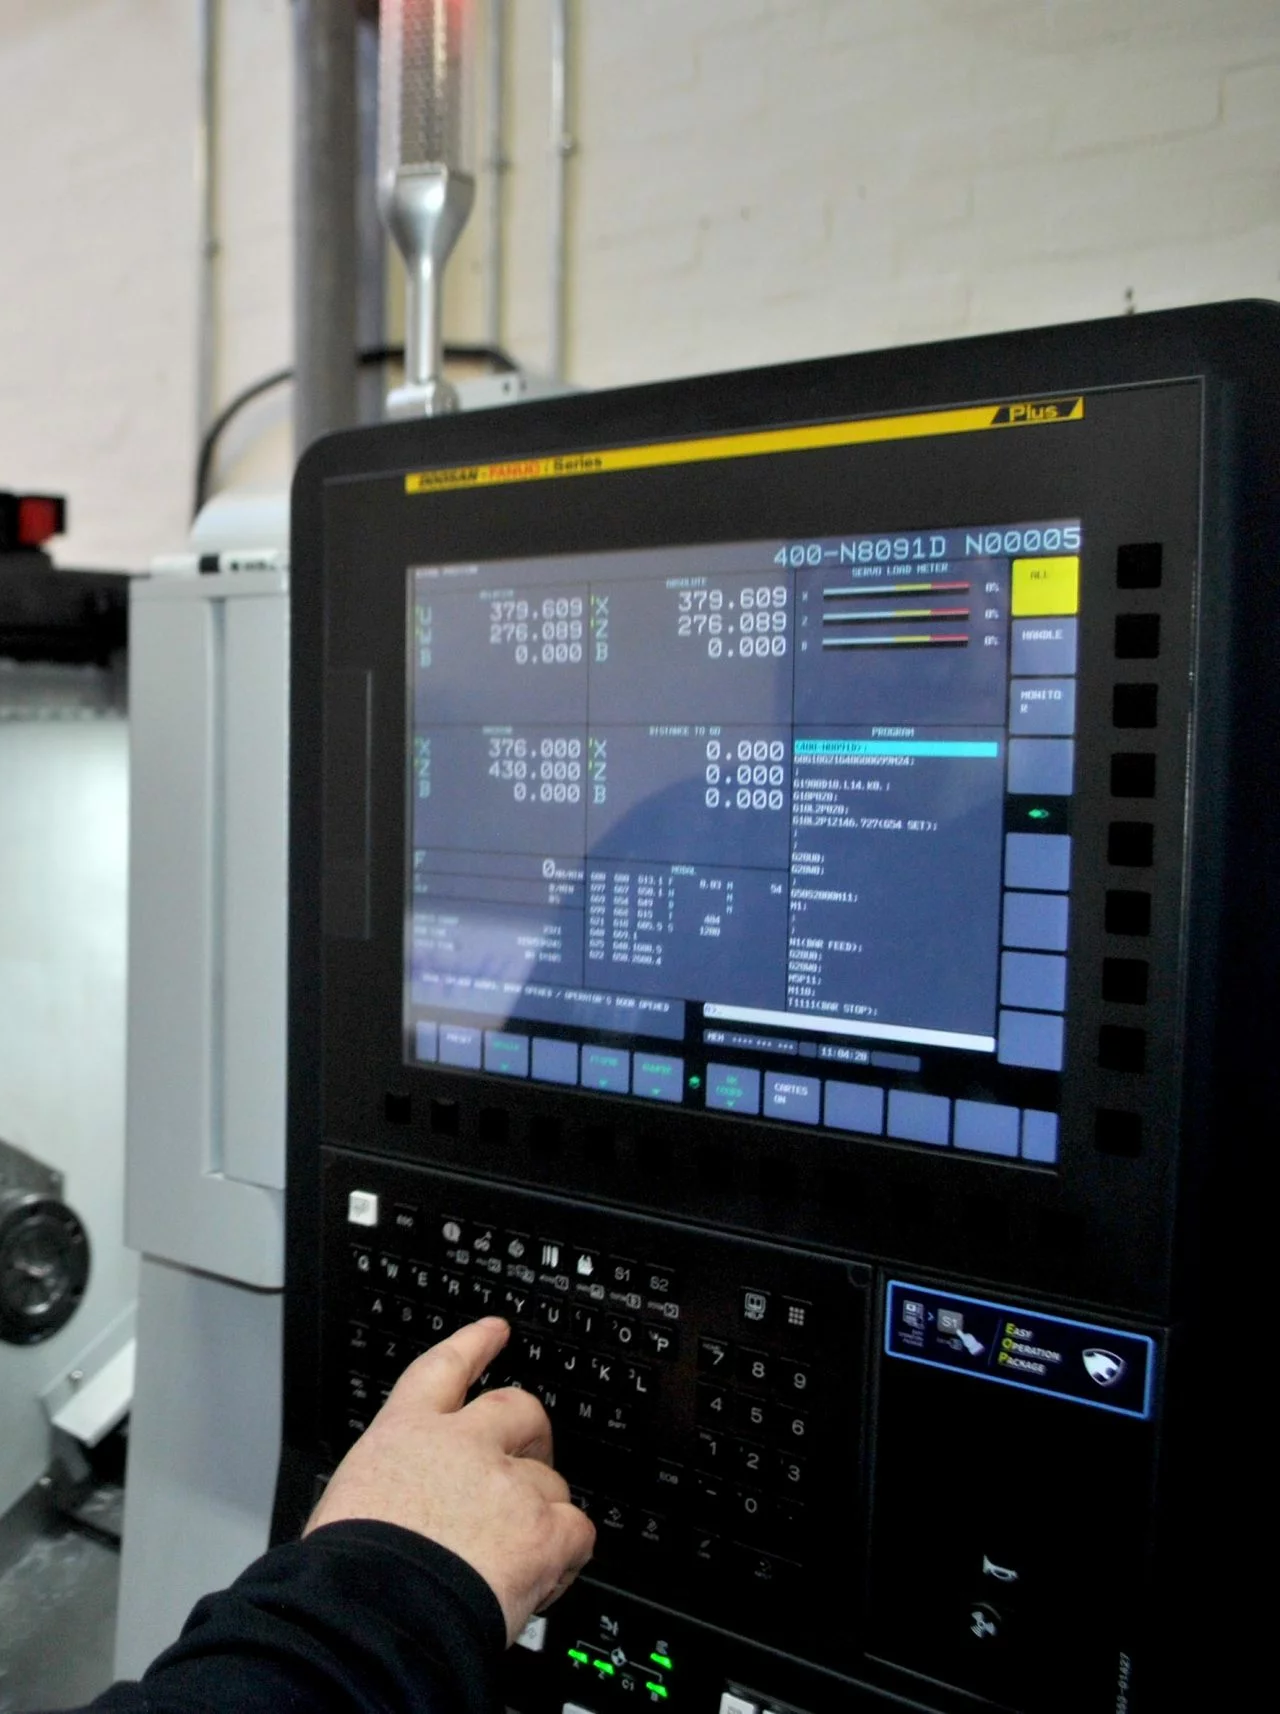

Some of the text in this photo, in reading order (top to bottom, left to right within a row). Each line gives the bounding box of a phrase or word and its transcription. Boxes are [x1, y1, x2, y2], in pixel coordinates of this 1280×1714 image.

[1009, 402, 1058, 423] Plus
[554, 455, 602, 473] Series
[774, 527, 1081, 568] 400-N8091D N00005
[887, 564, 912, 576] LOAD
[917, 562, 949, 574] METER
[489, 597, 583, 622] 379.609
[678, 586, 787, 612] 379.609
[489, 621, 583, 645] 276.089
[678, 611, 787, 637] 276.089
[515, 643, 583, 665] 0.000
[595, 635, 787, 662] B 0.000
[488, 738, 582, 760] 376.000
[705, 739, 785, 763] 0.000
[488, 760, 582, 781] 430.000
[705, 763, 785, 786] 0.000
[513, 781, 581, 803] 0.000
[593, 785, 785, 811] B 0.000
[543, 858, 556, 878] 0
[615, 1266, 669, 1293] S1 S2
[358, 1255, 370, 1271] Q
[387, 1263, 399, 1278] W
[417, 1271, 428, 1287] E
[448, 1279, 460, 1296] R
[481, 1290, 491, 1303] T
[514, 1299, 525, 1313] Y
[549, 1308, 560, 1323] U
[657, 1338, 669, 1352] P
[942, 1315, 958, 1329] S1
[372, 1299, 383, 1313] A
[432, 1316, 444, 1330] D
[529, 1345, 541, 1360] H
[565, 1357, 576, 1370] J
[600, 1366, 611, 1380] K
[636, 1376, 647, 1392] L
[1002, 1336, 1063, 1363] OPERATION
[712, 1349, 806, 1389] 7 8 9
[998, 1351, 1047, 1376] PACKAGE
[386, 1342, 396, 1357] Z
[545, 1392, 556, 1408] N
[580, 1402, 592, 1418] M
[710, 1397, 805, 1436] 4 5 6
[709, 1442, 800, 1482] 1 2 3
